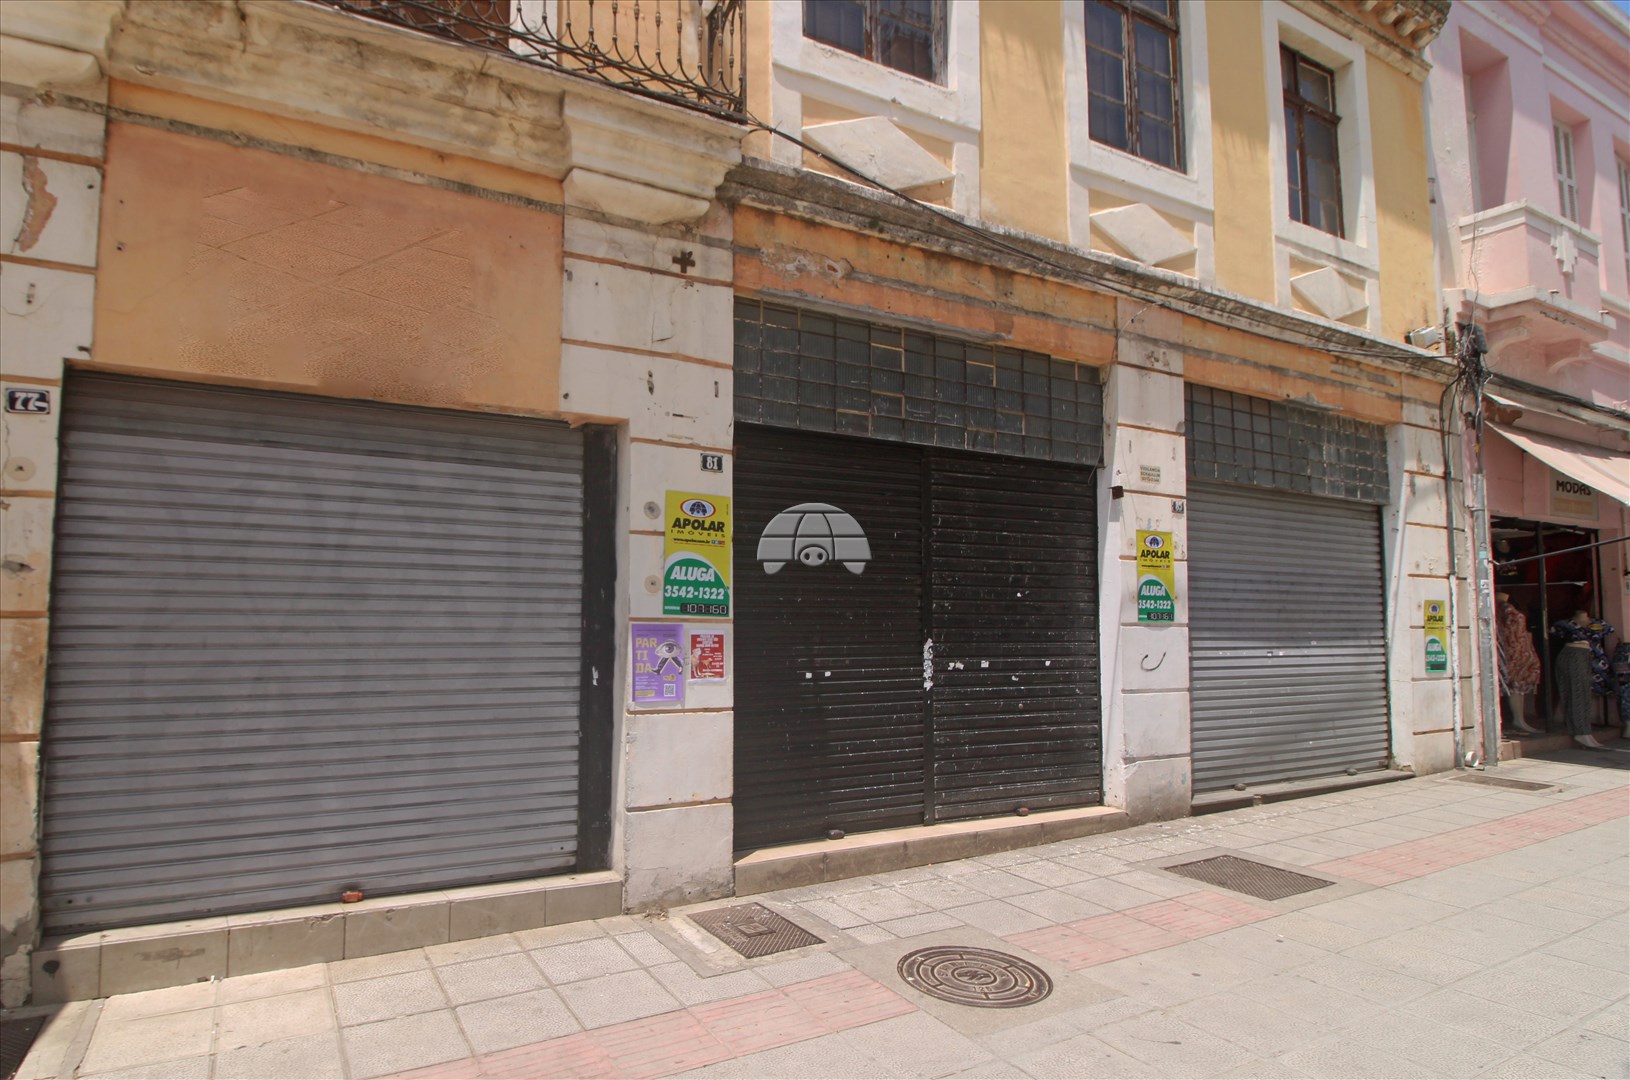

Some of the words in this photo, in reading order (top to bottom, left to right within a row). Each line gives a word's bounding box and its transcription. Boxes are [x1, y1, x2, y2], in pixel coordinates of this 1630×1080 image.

[706, 456, 719, 470] 81
[1555, 479, 1592, 496] MODAS
[671, 517, 725, 533] APOLAR
[1140, 549, 1171, 560] APOLAR
[670, 565, 715, 582] ALUGA
[664, 585, 725, 600] 3542-1322
[1141, 584, 1166, 596] ALUGA
[1138, 599, 1172, 610] 3542-1322
[635, 637, 657, 648] PAR
[635, 649, 648, 661] TI
